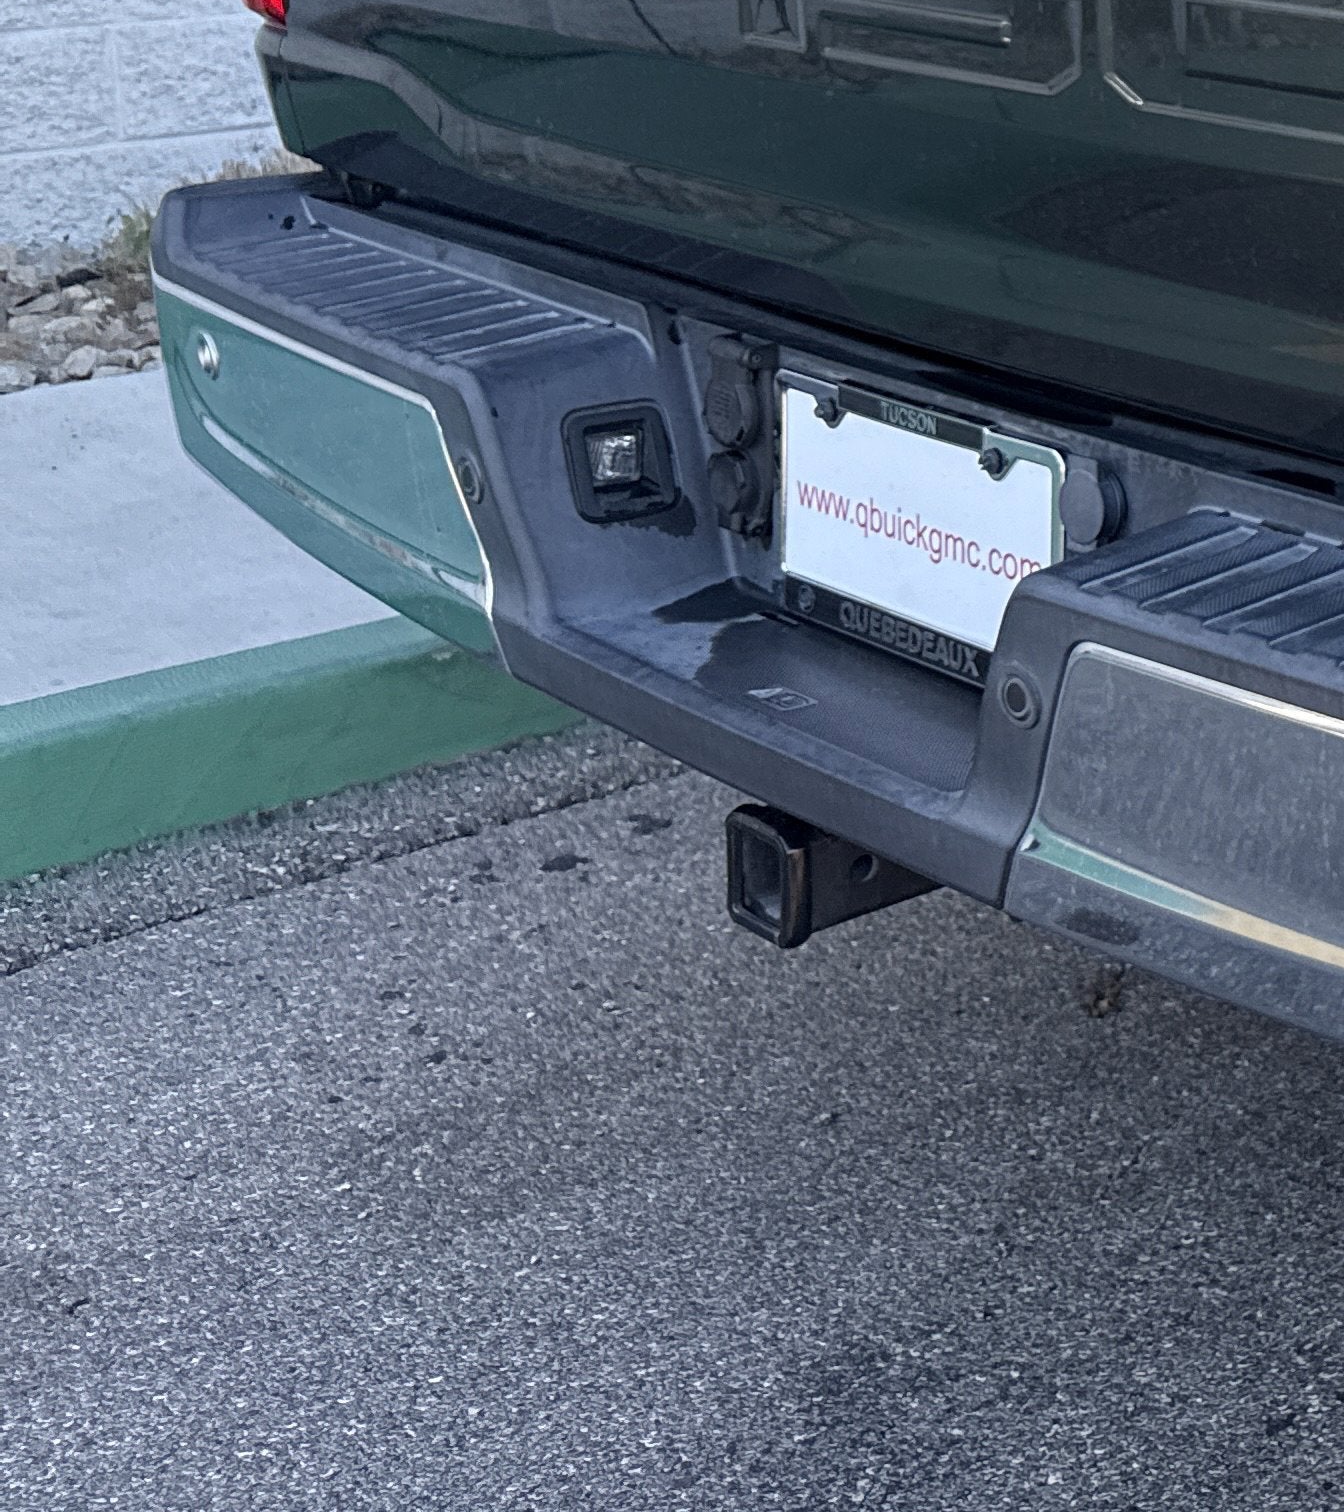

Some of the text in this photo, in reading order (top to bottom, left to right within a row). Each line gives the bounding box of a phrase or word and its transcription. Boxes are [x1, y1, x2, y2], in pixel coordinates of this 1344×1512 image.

[880, 399, 938, 436] TUCSON
[797, 479, 1041, 580] www.qbuickgmc.com
[838, 600, 980, 678] QUEBEDEAUX
